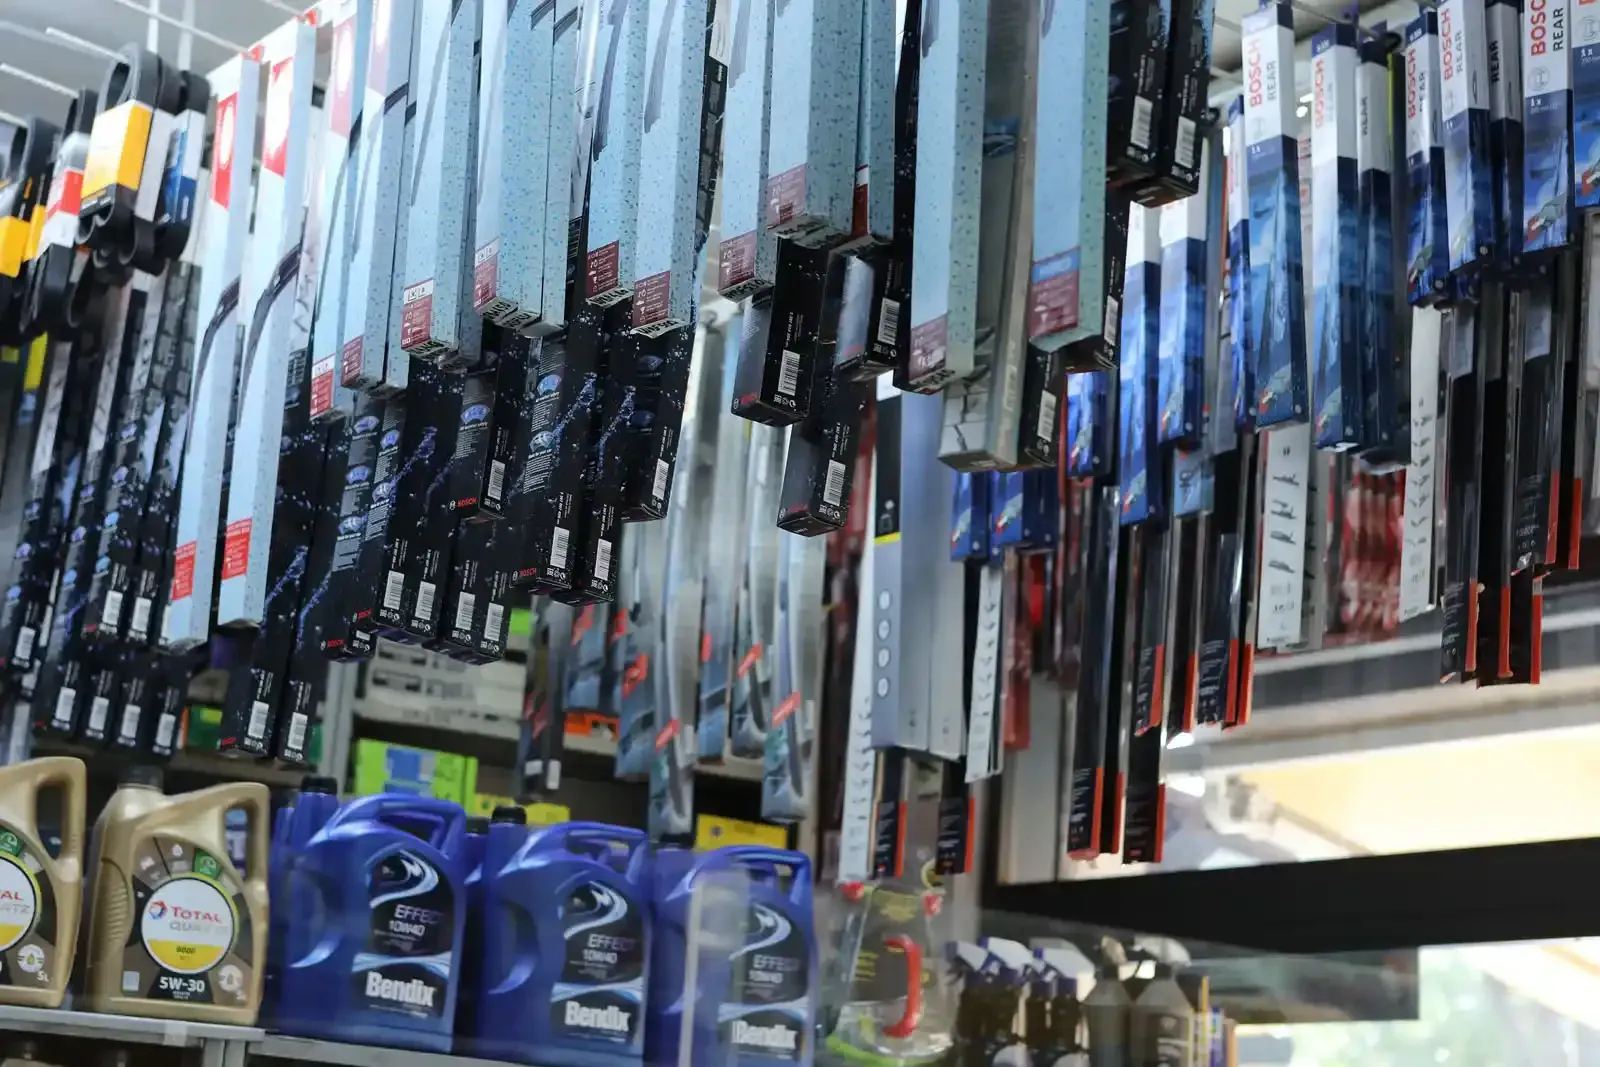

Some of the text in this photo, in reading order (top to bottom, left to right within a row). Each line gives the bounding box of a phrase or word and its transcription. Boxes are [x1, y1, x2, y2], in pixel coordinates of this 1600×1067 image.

[1441, 9, 1453, 81] BOSCH
[1530, 0, 1546, 56] BOSC
[1553, 8, 1564, 51] REAR
[1455, 30, 1463, 74] REAR
[1490, 40, 1499, 82] REAR
[1249, 39, 1262, 107] BOSCH
[1267, 60, 1277, 101] REAR
[1315, 56, 1325, 128] BOSCH
[1408, 48, 1416, 119] BOSCH
[519, 568, 536, 577] BOSCH
[0, 890, 24, 901] AL
[171, 906, 222, 923] TOTAL
[37, 971, 49, 982] 5L
[159, 976, 205, 992] 5W-30
[365, 971, 435, 1007] Bendix
[564, 1000, 631, 1032] Bendix
[732, 1020, 798, 1049] Bendix
